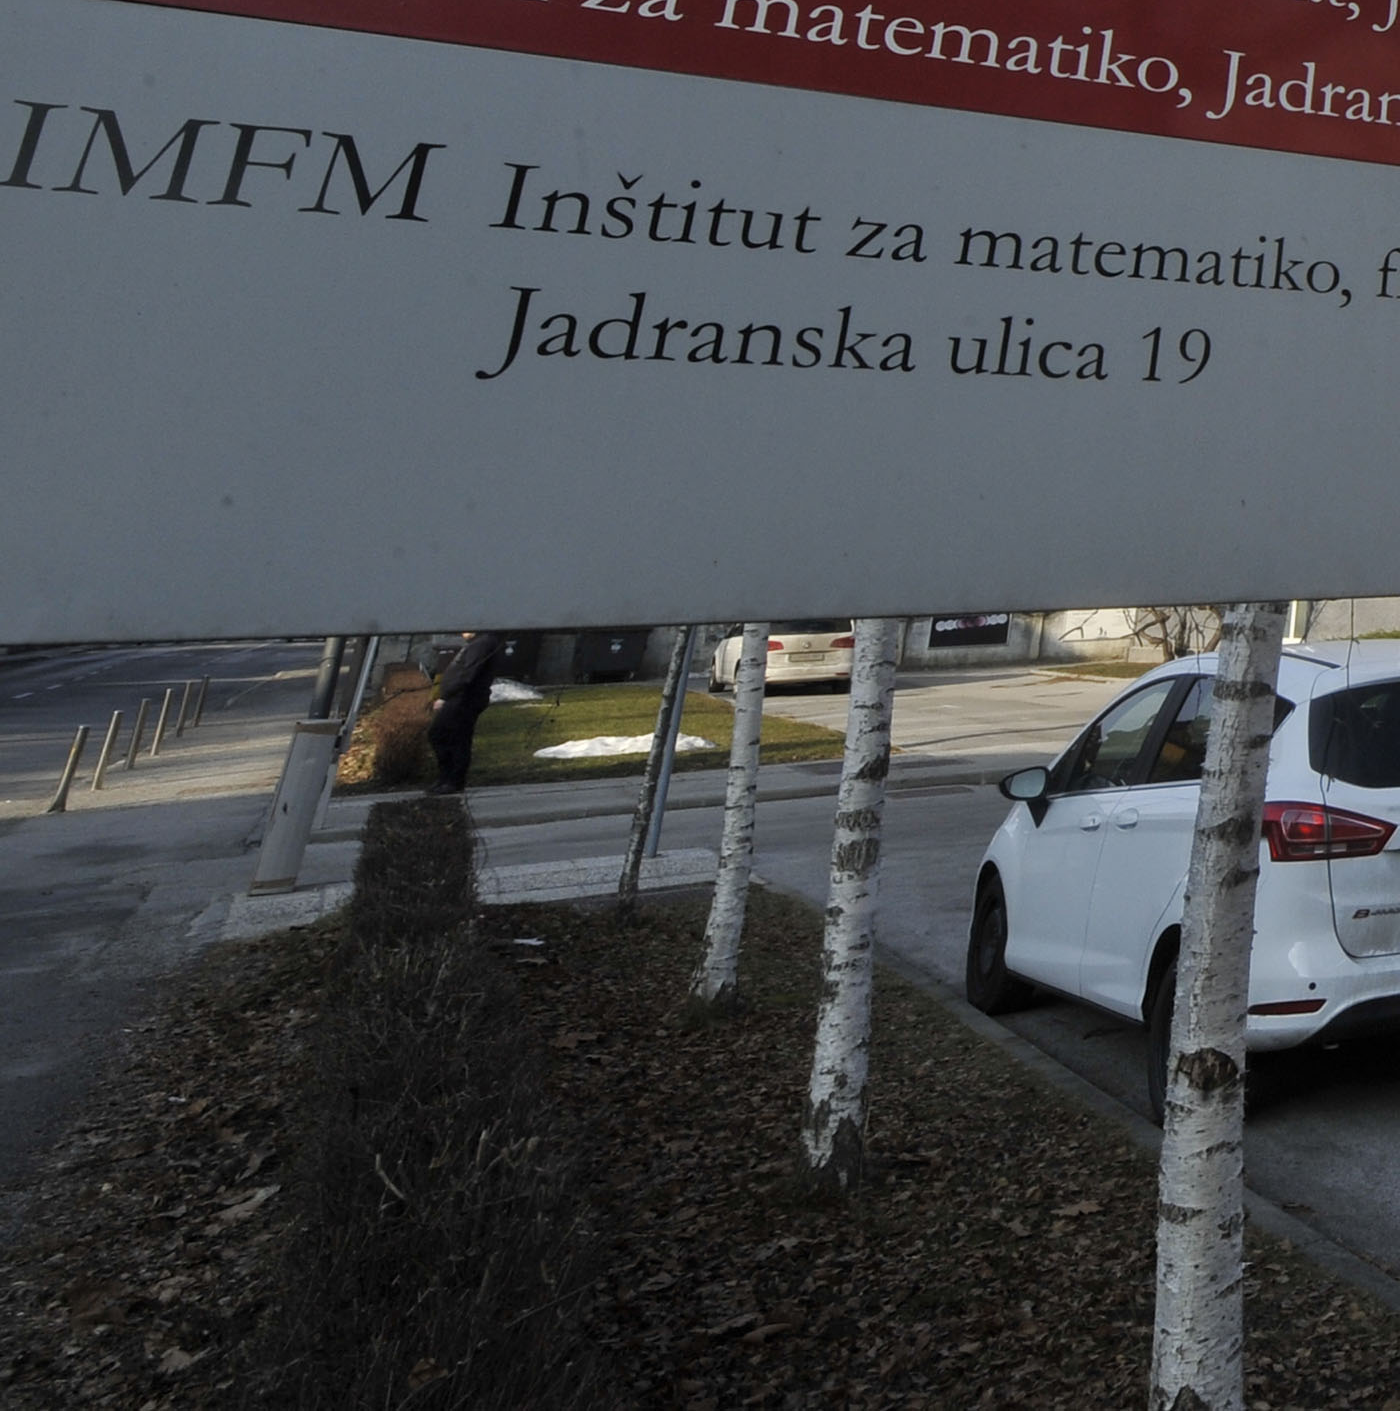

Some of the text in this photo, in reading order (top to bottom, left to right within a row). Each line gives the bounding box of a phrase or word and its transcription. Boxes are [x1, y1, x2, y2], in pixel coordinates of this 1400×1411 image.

[0, 100, 447, 222] IMFM
[489, 163, 821, 253] Inštitut
[845, 217, 927, 262] za
[954, 228, 1351, 308] matematiko,
[475, 286, 1211, 384] Jadranska ulica 19
